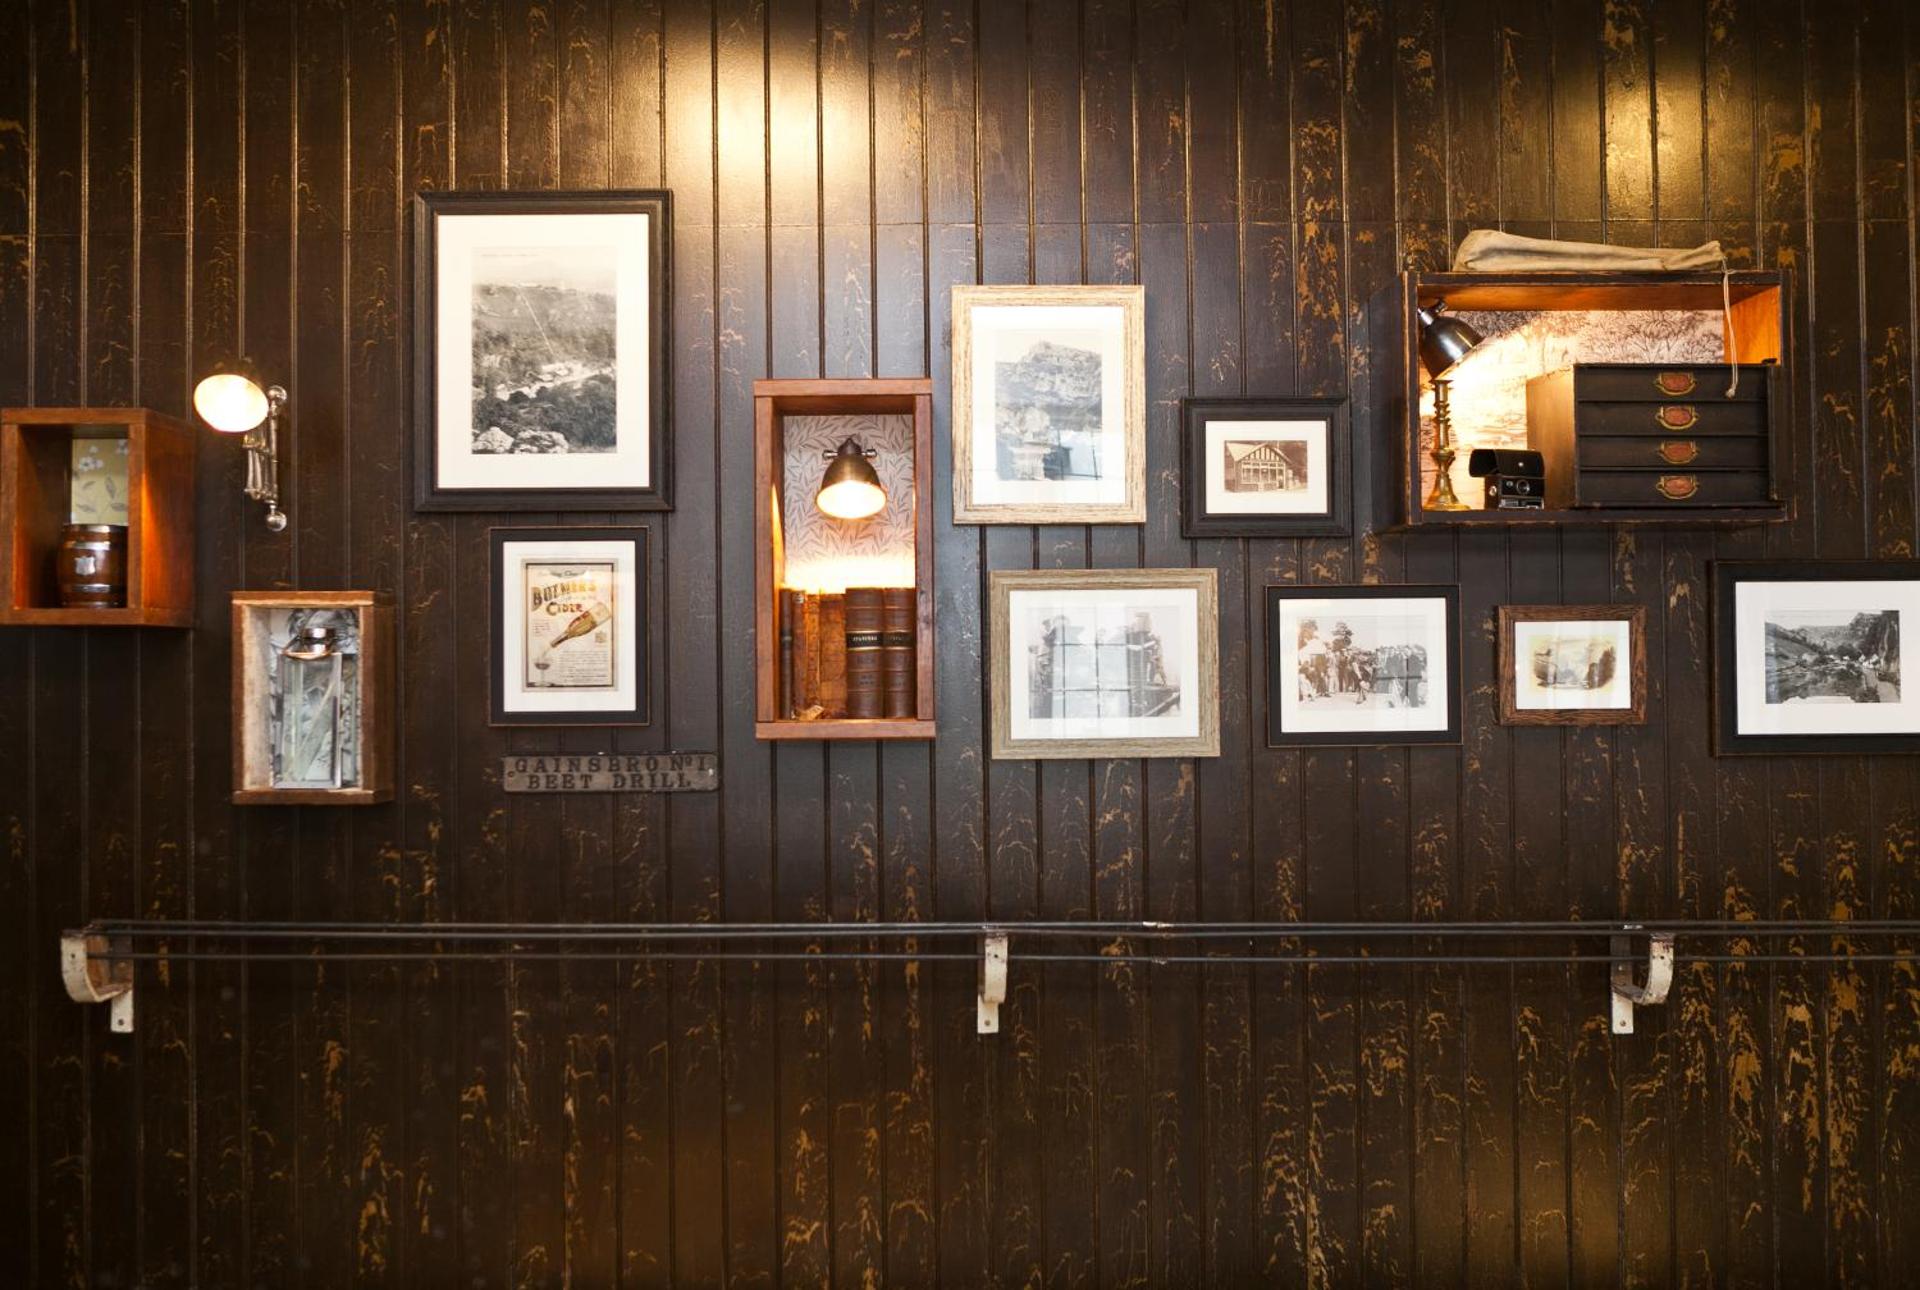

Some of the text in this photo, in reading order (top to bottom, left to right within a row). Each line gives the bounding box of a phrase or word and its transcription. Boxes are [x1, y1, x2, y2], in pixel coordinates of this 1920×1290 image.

[546, 602, 583, 616] CIDER
[515, 757, 659, 772] GAINSBRO
[528, 773, 691, 789] BEET DRILL
